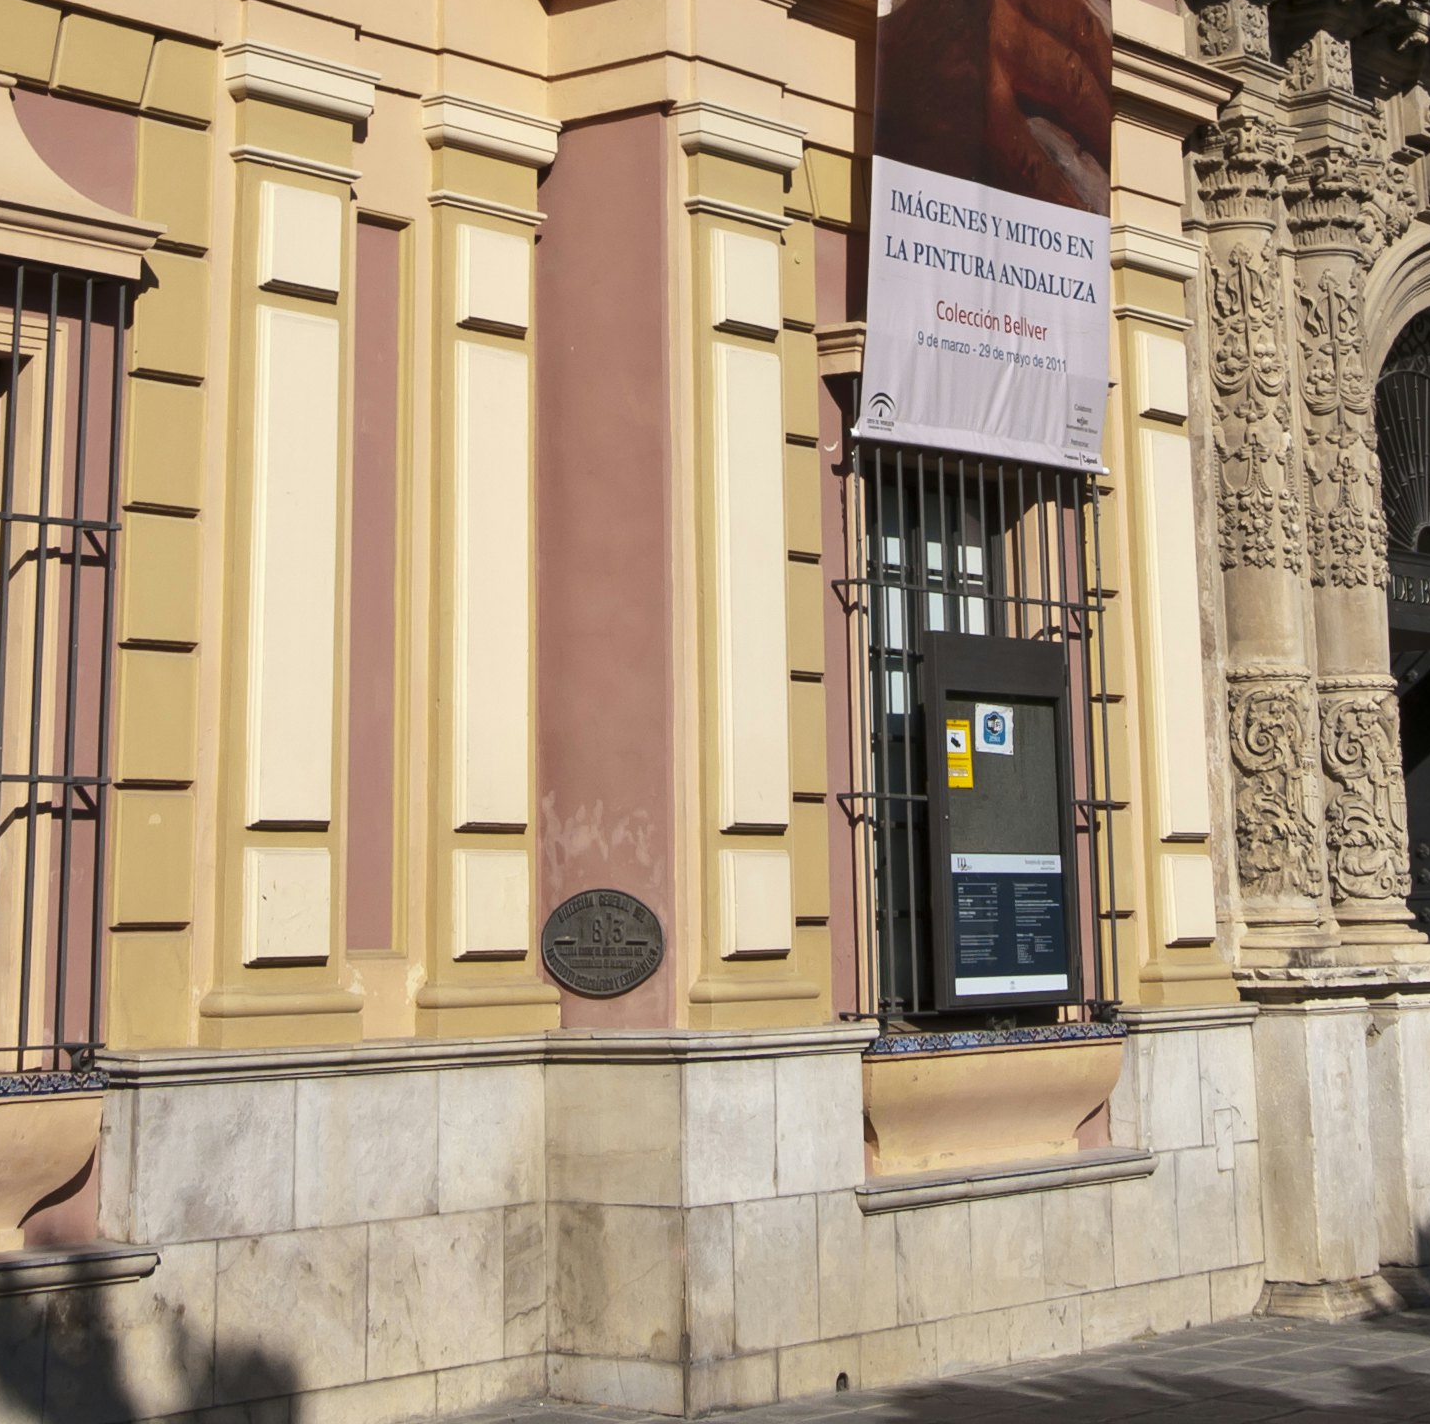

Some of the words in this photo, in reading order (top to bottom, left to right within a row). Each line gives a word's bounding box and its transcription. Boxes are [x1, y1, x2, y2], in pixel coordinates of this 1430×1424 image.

[891, 189, 987, 234] IMÁGENES
[991, 215, 1002, 237] Y
[1006, 220, 1062, 253] MITOS
[1066, 234, 1094, 260] EN
[885, 235, 908, 261] LA
[913, 242, 996, 282] PINTURA
[999, 263, 1096, 304] ANDALUZA
[936, 300, 1000, 331] Colección
[1004, 314, 1048, 341] Bellver
[917, 331, 924, 346] 9
[926, 333, 938, 348] de
[941, 338, 970, 355] marzo
[979, 343, 990, 358] 29
[993, 346, 1004, 361] de
[1006, 351, 1030, 367] mayo
[1032, 354, 1043, 368] de
[1046, 356, 1066, 372] 2011
[1392, 574, 1416, 603] DE
